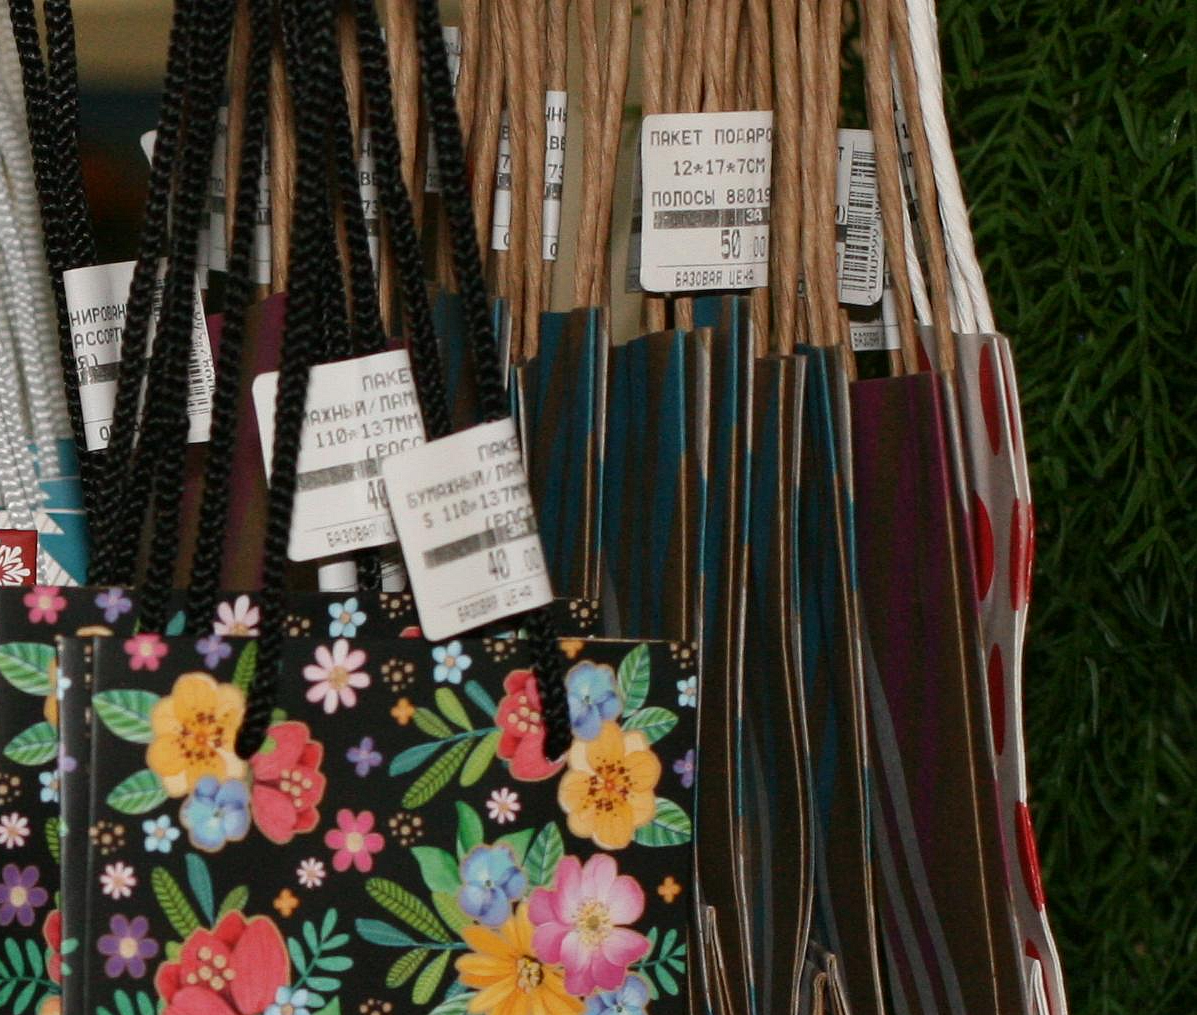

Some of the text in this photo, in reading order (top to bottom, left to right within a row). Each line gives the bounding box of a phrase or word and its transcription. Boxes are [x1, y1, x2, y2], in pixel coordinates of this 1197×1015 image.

[650, 129, 703, 147] ПАКЕТ
[652, 189, 715, 207] ПОЛОСЫ
[720, 229, 741, 260] 50
[674, 268, 755, 288] БАЗОВАЯ ЦЕНА
[70, 303, 128, 328] НИРОВАН
[487, 549, 511, 581] 40
